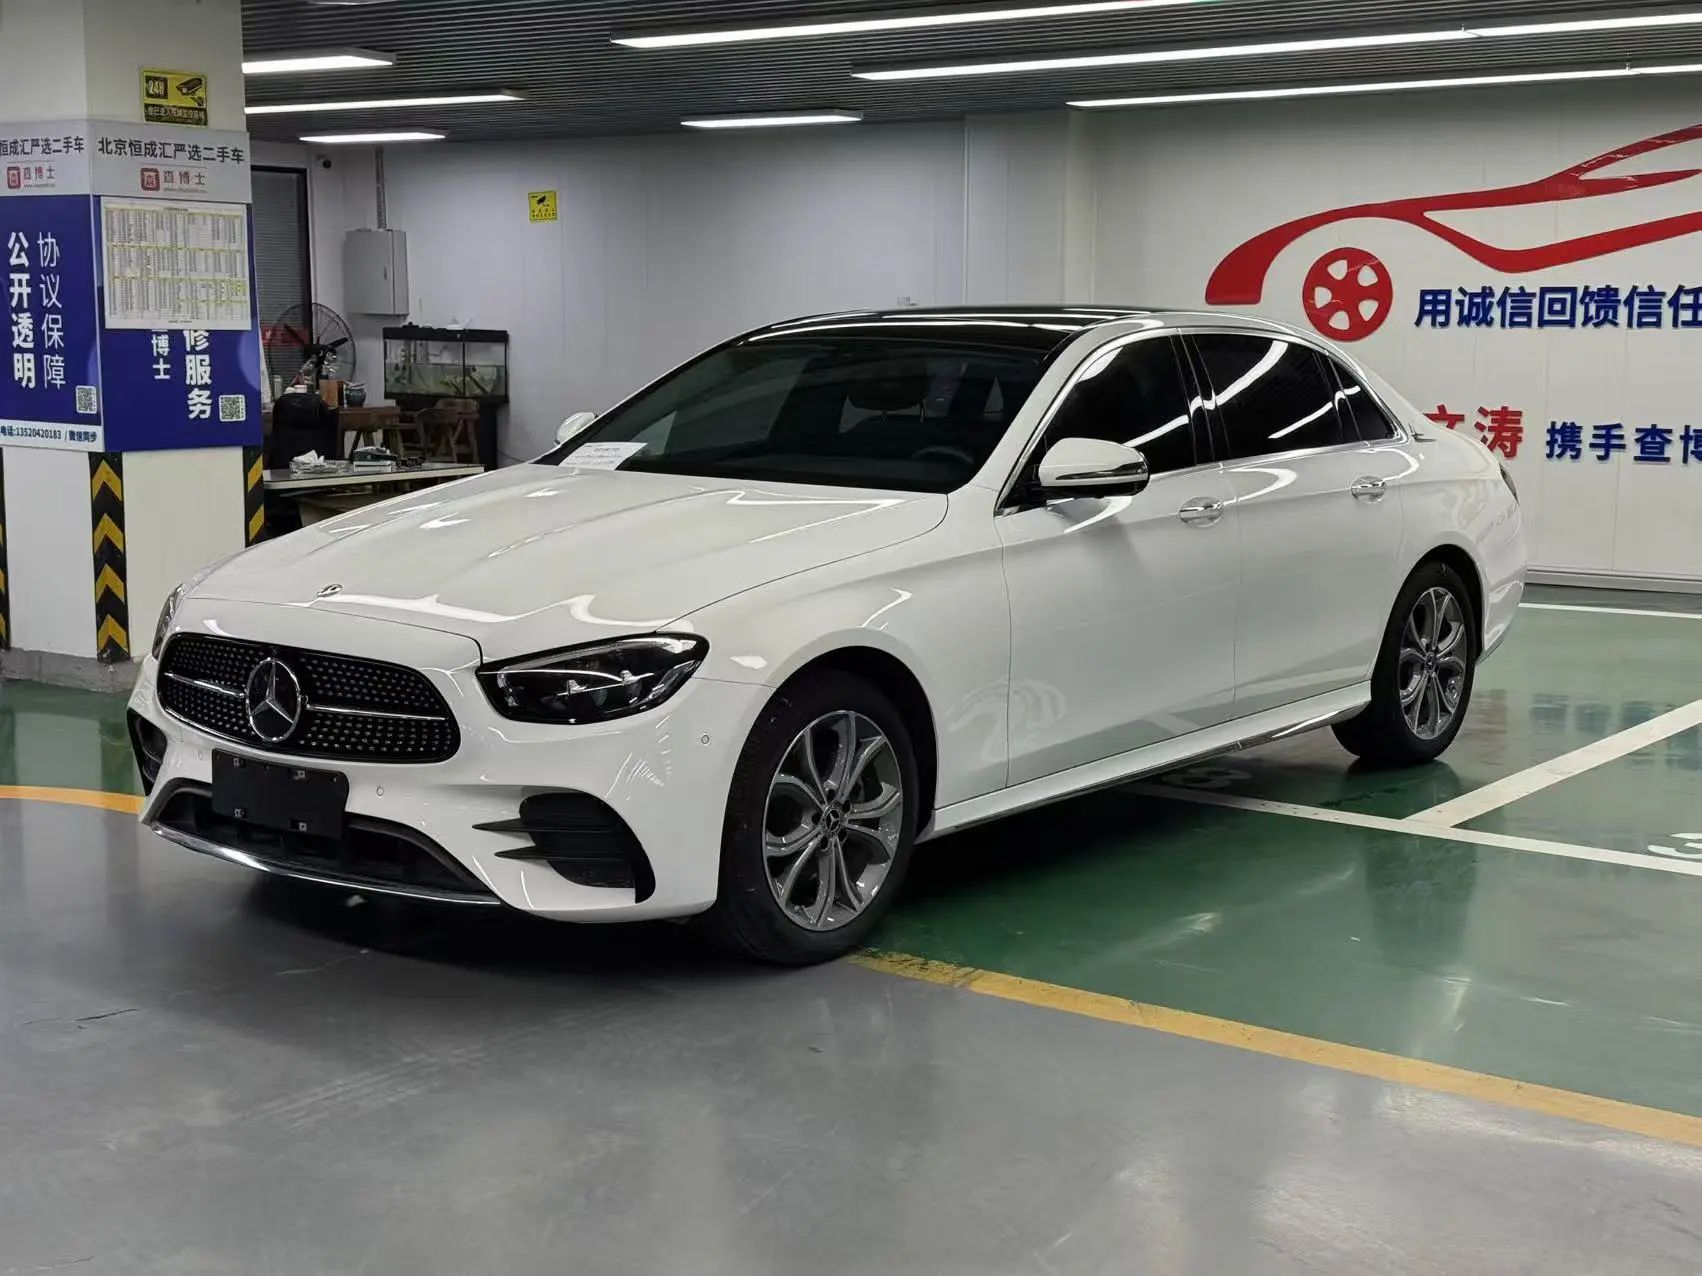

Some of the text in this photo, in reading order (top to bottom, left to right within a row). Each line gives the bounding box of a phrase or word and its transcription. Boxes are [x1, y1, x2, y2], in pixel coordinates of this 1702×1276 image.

[0, 136, 84, 156] 恒成汇严选二手车
[98, 137, 244, 163] 北京恒成汇严选二手车
[7, 232, 35, 388] 公开透明
[37, 232, 66, 389] 协议保障
[1414, 284, 1702, 329] 用诚信回馈信任
[151, 330, 171, 380] 博士
